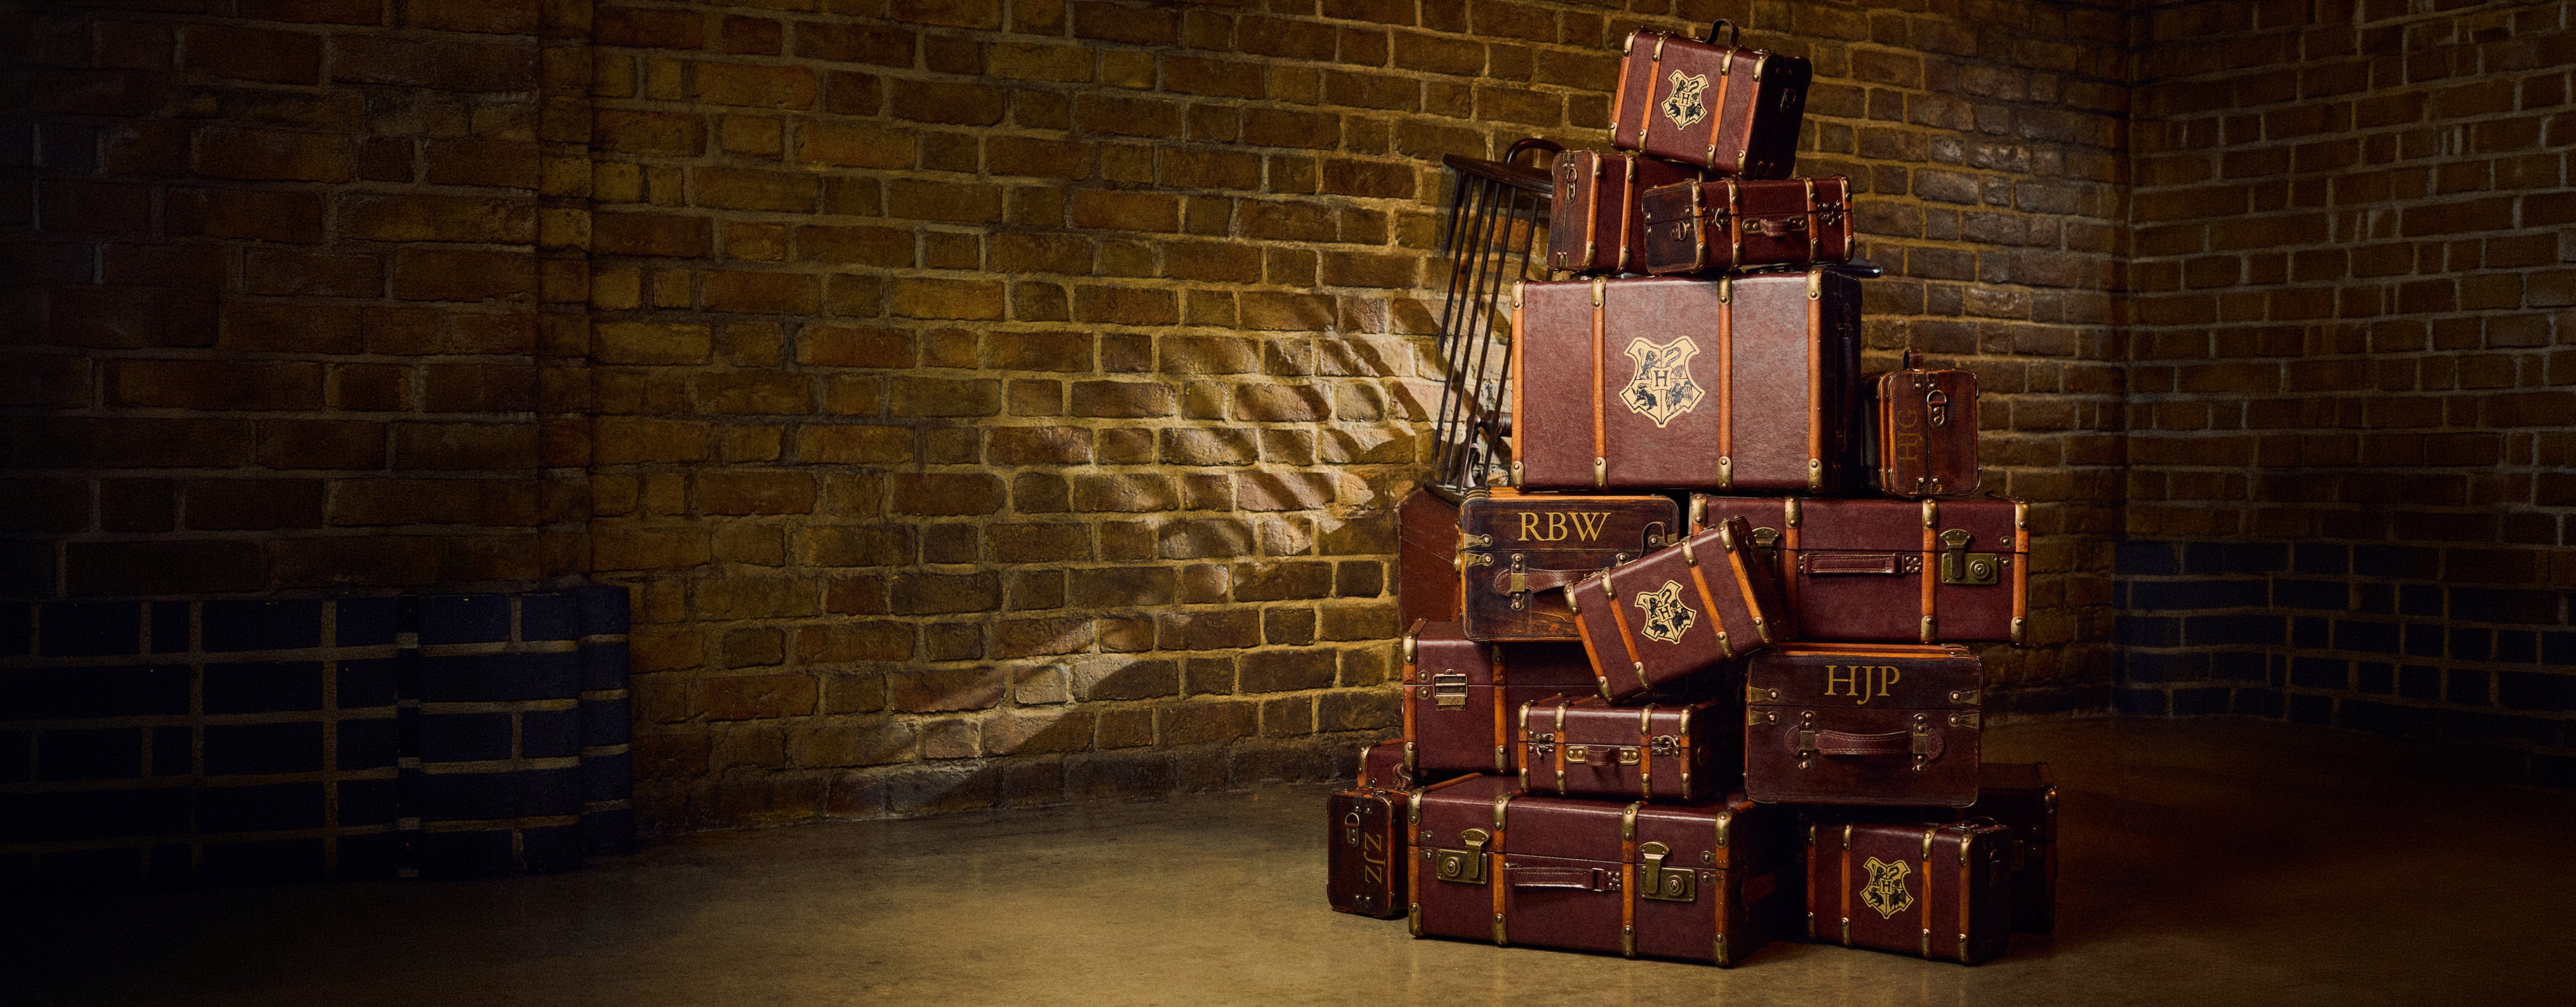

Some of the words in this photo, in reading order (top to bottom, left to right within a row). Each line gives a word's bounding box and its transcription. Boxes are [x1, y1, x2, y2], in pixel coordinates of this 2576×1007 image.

[1681, 93, 1691, 105] H
[1653, 370, 1669, 387] H
[1897, 409, 1923, 461] HJG
[1518, 512, 1612, 542] RBW
[1658, 605, 1671, 619] H
[1824, 665, 1901, 705] HJP
[1363, 831, 1386, 885] ZJZ
[1881, 880, 1892, 893] H
